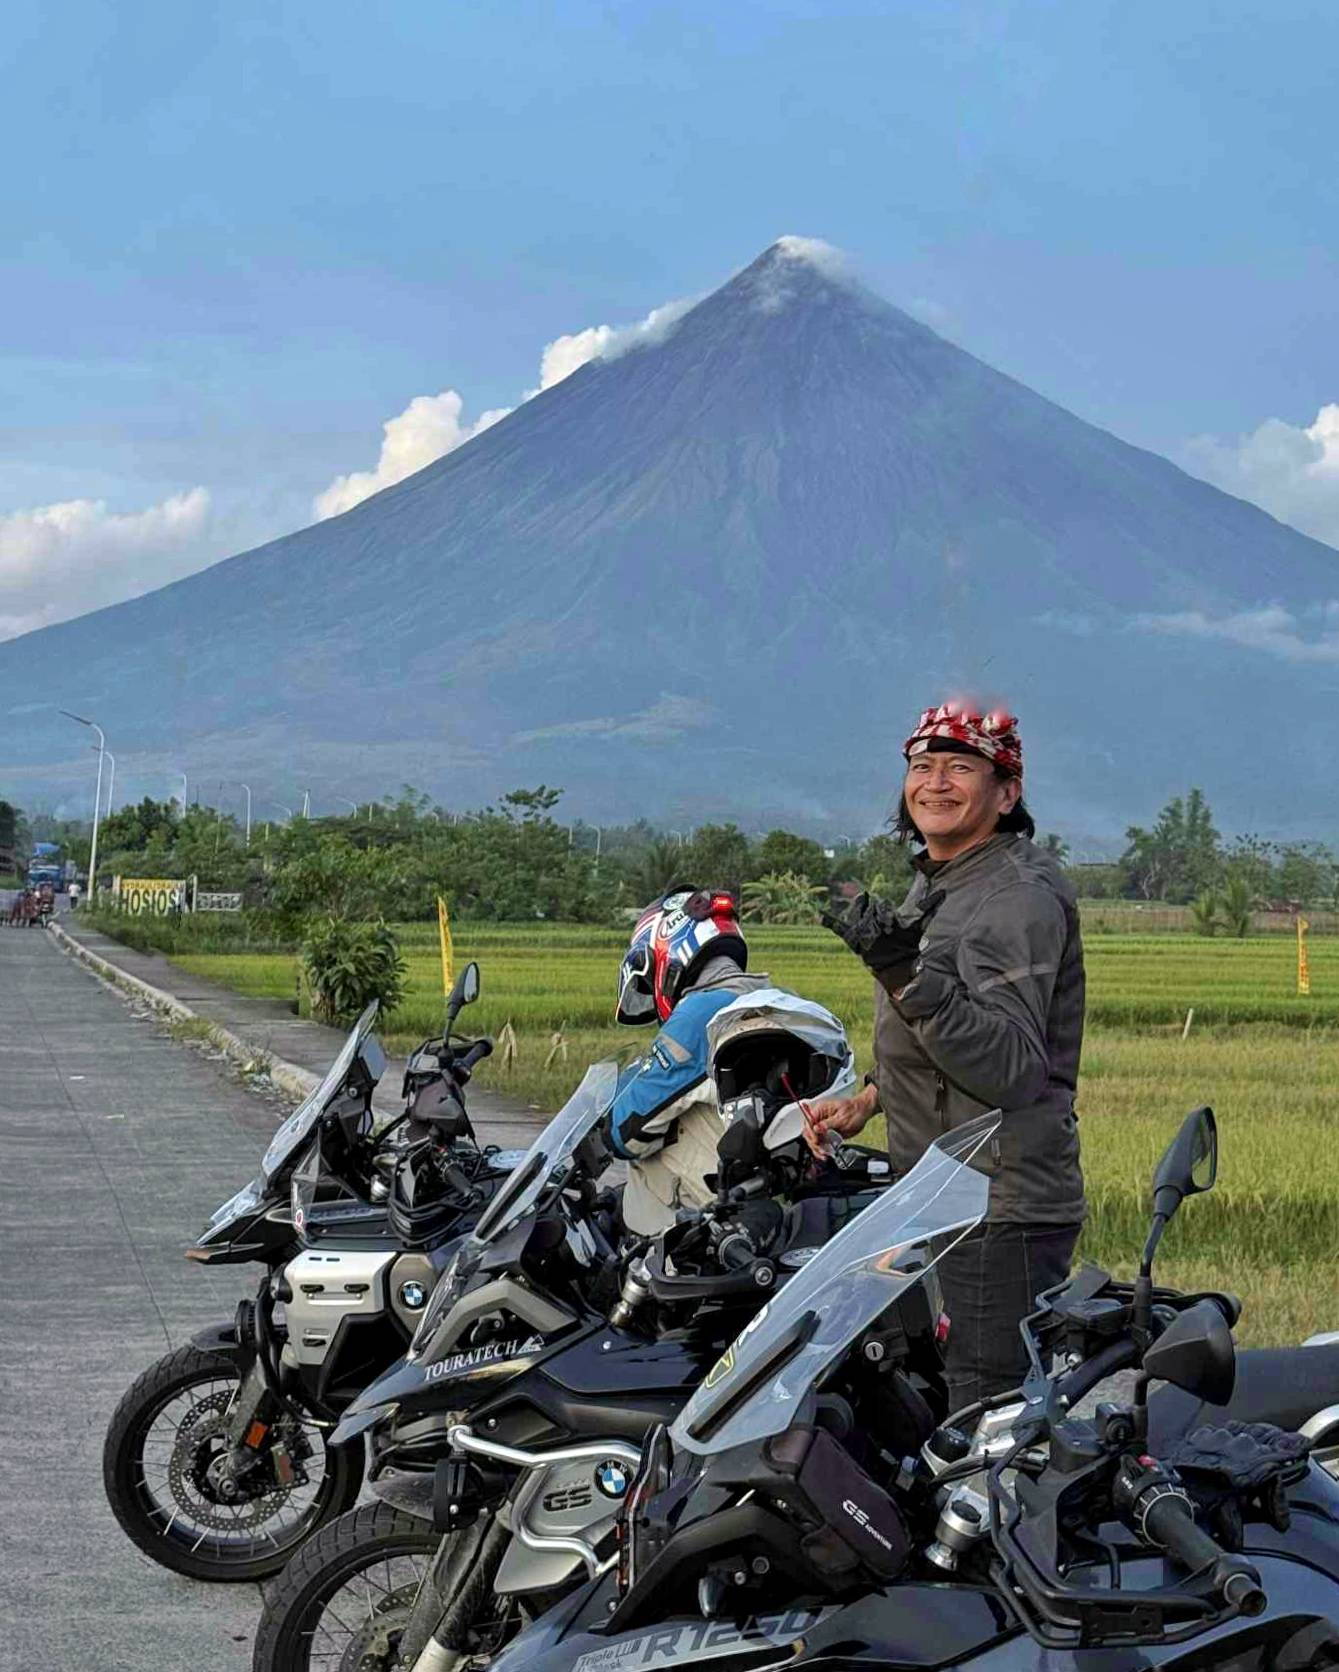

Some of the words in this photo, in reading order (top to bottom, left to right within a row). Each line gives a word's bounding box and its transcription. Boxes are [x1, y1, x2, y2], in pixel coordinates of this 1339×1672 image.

[424, 1338, 519, 1382] TOURATECH
[543, 1486, 593, 1512] GS
[842, 1499, 870, 1526] GS
